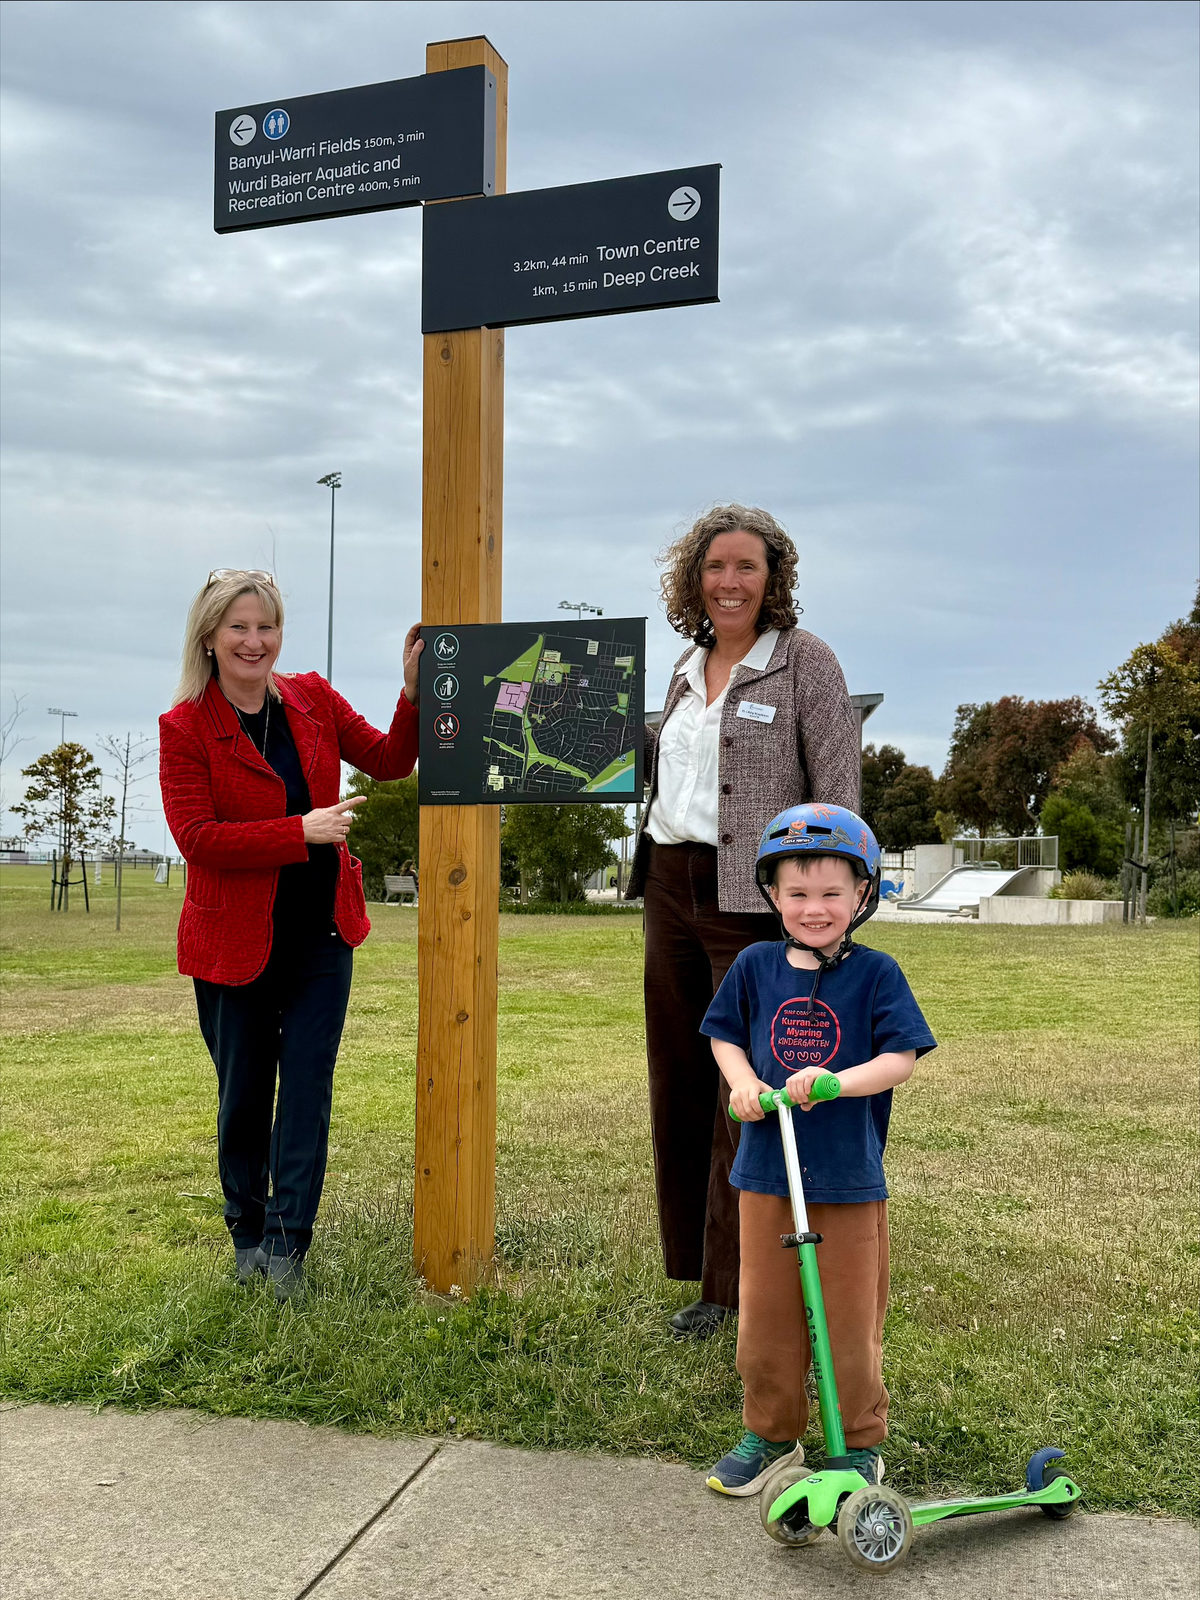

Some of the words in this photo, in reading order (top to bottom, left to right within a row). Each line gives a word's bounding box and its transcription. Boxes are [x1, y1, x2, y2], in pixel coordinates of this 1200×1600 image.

[229, 143, 315, 170] Banyul-Warri
[319, 136, 361, 156] Fields
[364, 136, 395, 149] 150m,
[397, 133, 404, 144] 3
[406, 130, 425, 142] min
[228, 175, 267, 195] Wurdi
[271, 171, 313, 188] Baierr
[315, 160, 370, 183] Aquatic
[373, 155, 401, 173] and
[229, 190, 303, 213] Recreation
[306, 182, 355, 201] Centre
[358, 180, 391, 193] 400m,
[393, 178, 400, 188] 5
[402, 174, 421, 187] min
[513, 259, 549, 272] 3.2km,
[552, 255, 567, 267] 44
[569, 253, 589, 265] min
[597, 244, 639, 261] Town
[643, 236, 700, 255] Centre
[532, 285, 558, 297] 1km,
[562, 282, 576, 293] 15
[578, 279, 598, 291] min
[603, 270, 646, 288] Deep
[650, 261, 700, 282] Creek
[778, 1037, 830, 1048] KINDERGARTEN
[786, 1027, 822, 1038] Myaring
